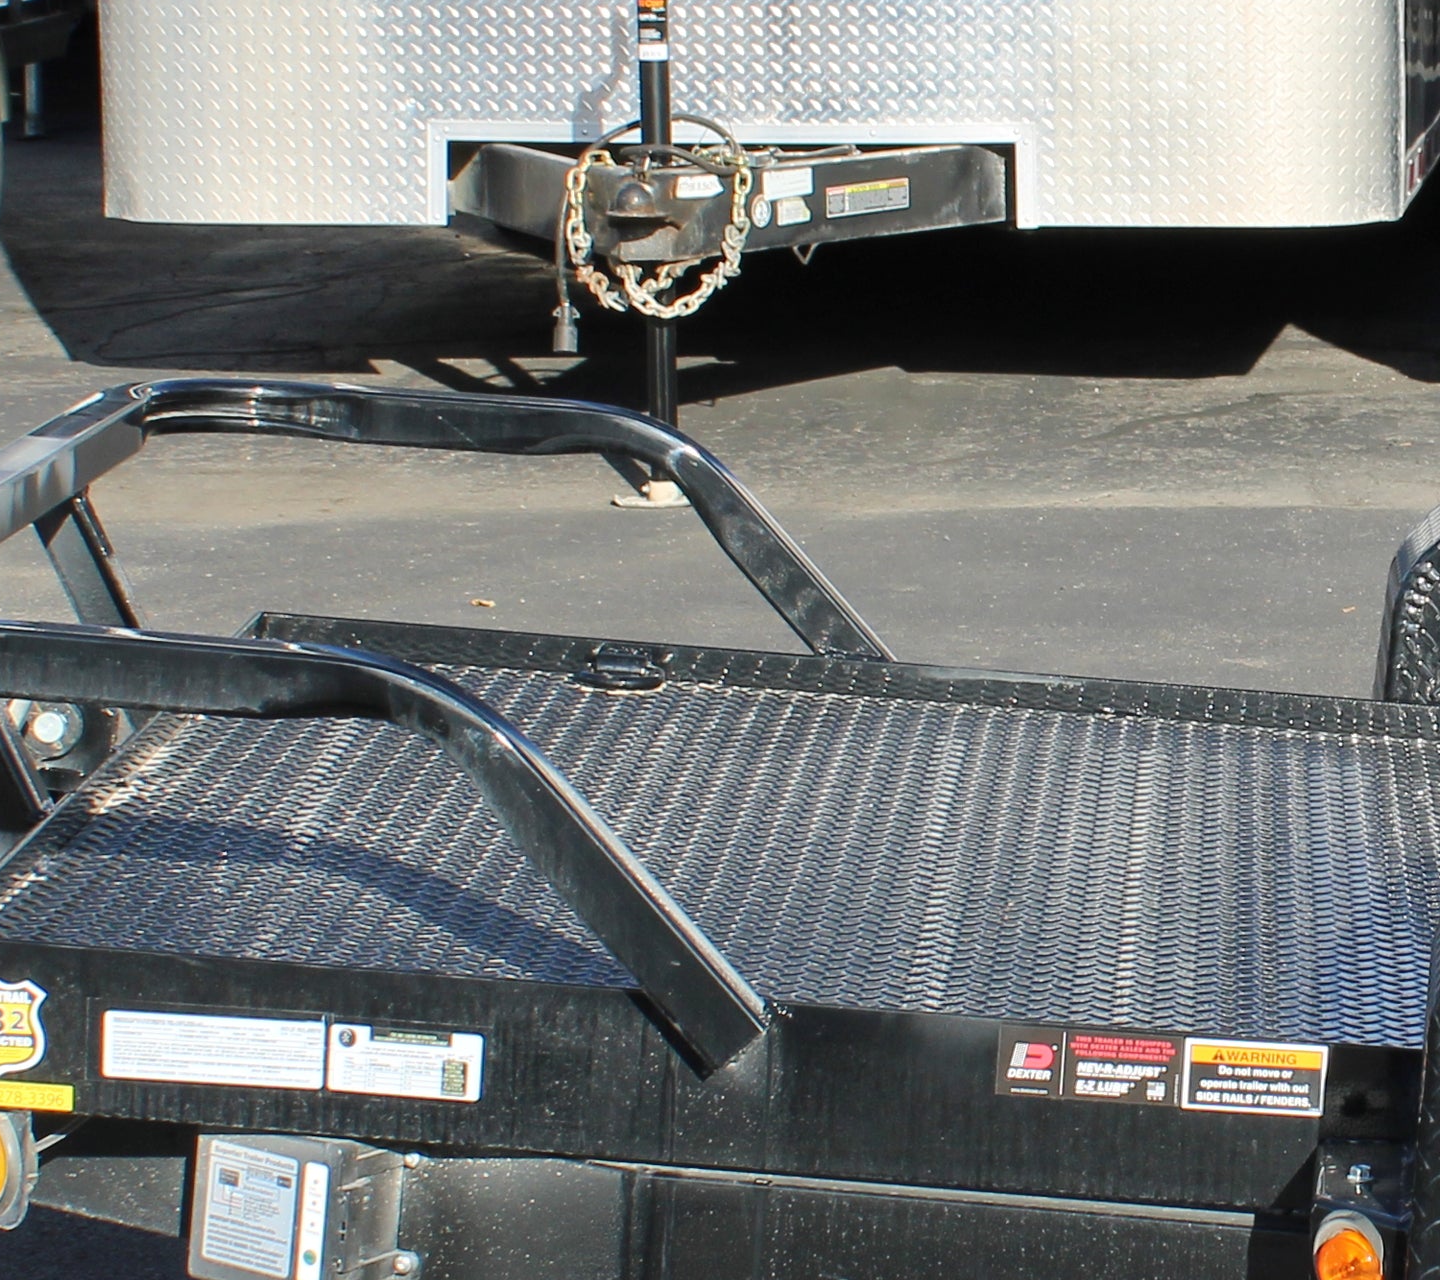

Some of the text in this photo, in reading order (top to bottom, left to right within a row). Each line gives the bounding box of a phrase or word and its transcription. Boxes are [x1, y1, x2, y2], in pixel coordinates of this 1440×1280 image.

[1225, 1051, 1297, 1065] WARNING
[1007, 1068, 1052, 1081] DEXTER
[1218, 1065, 1293, 1079] Do not move or
[1200, 1079, 1310, 1094] operate trailer with out
[1195, 1091, 1221, 1102] SIDE
[1221, 1092, 1253, 1104] RAILS
[1260, 1095, 1311, 1108] FENDERS.
